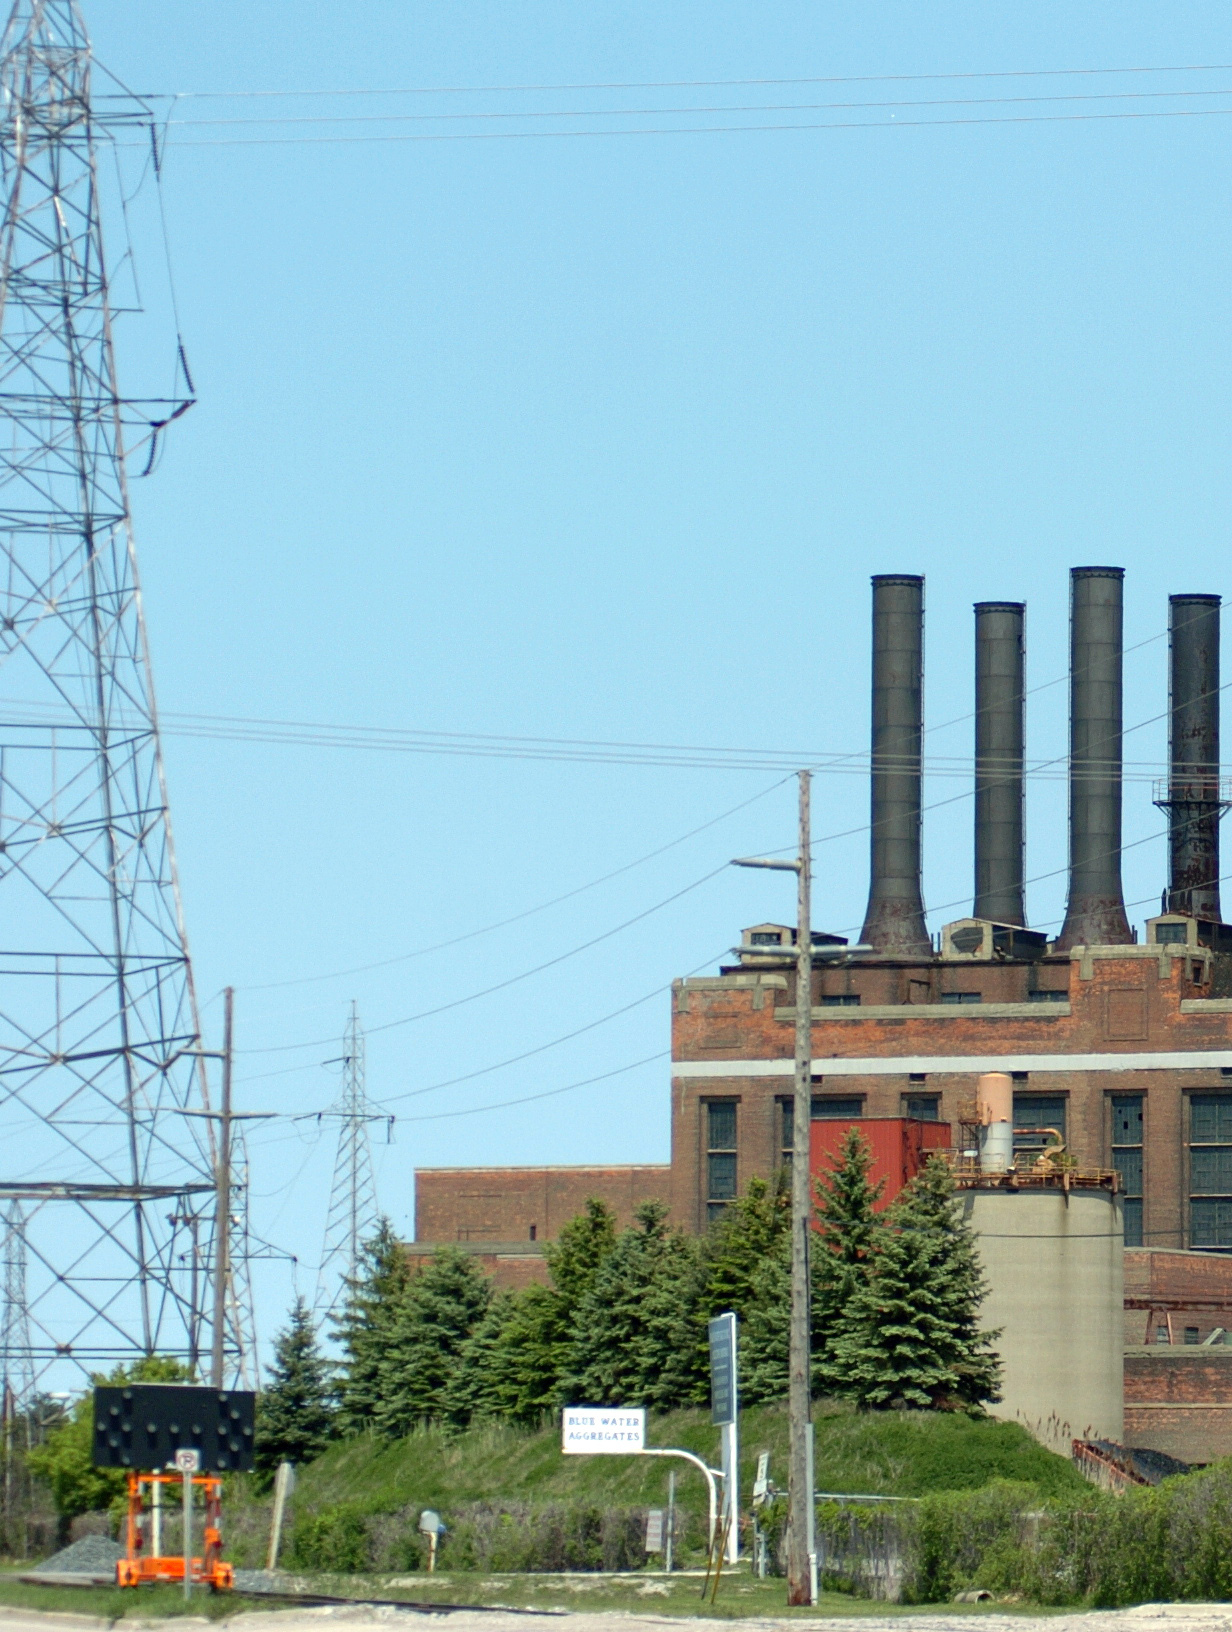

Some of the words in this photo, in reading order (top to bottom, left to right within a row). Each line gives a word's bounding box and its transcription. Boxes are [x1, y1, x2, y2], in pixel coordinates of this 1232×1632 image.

[568, 1416, 596, 1426] BLUE
[600, 1417, 640, 1427] WATER
[568, 1431, 640, 1441] AGGREGATES
